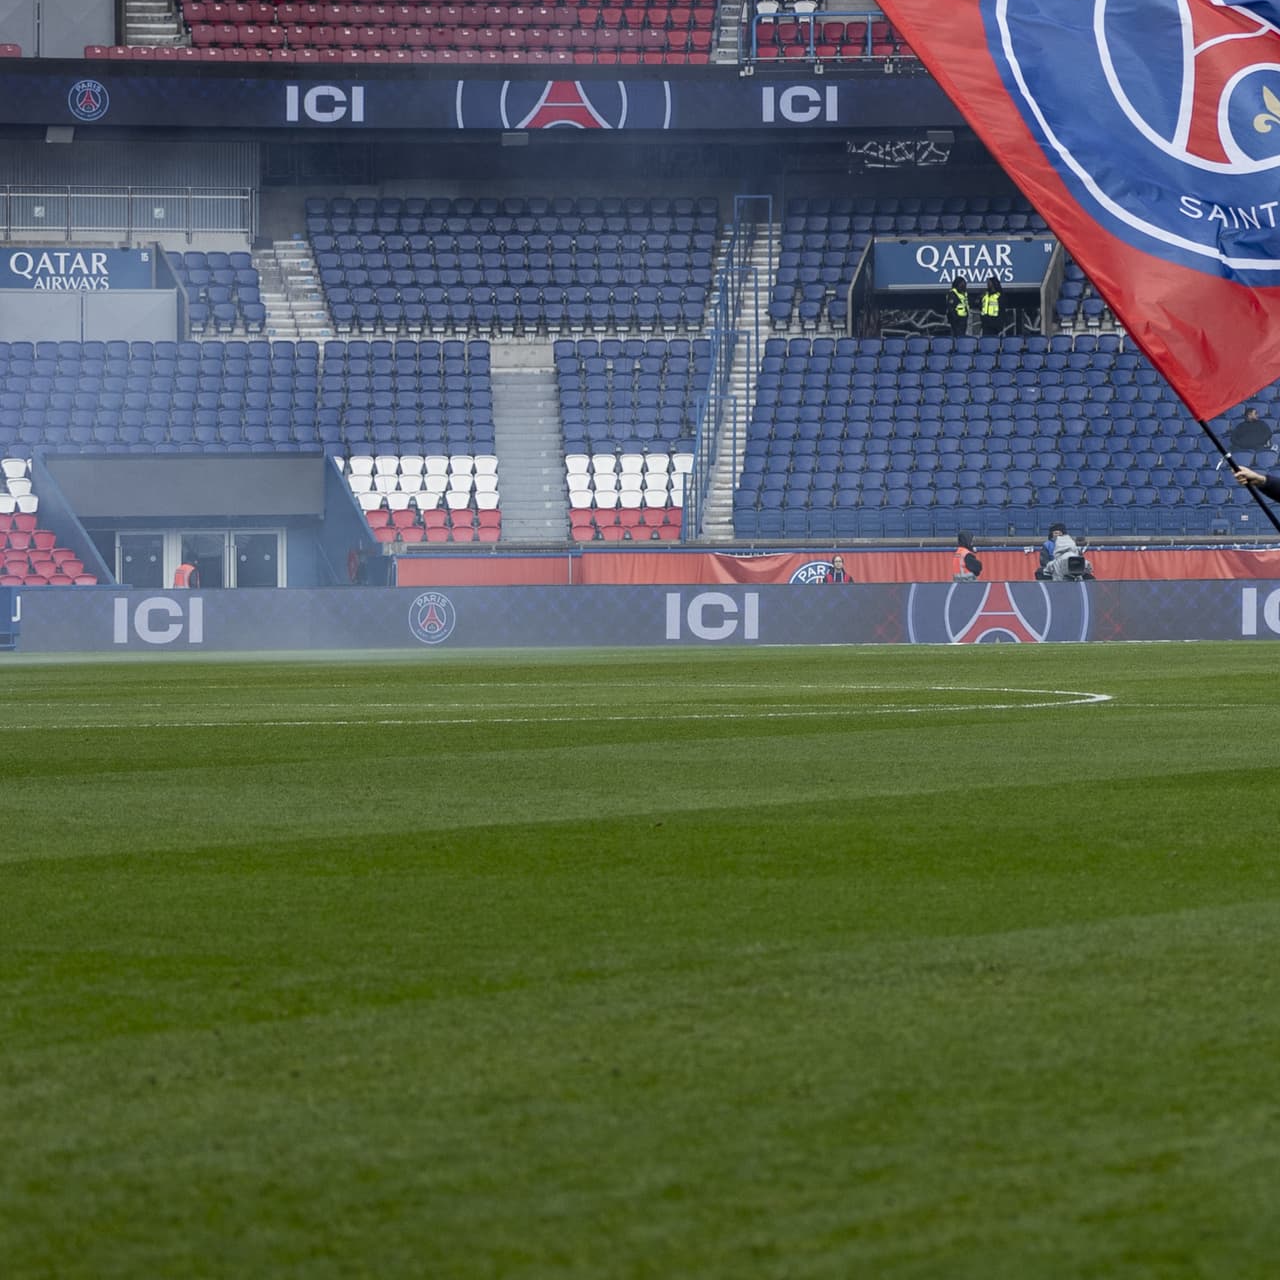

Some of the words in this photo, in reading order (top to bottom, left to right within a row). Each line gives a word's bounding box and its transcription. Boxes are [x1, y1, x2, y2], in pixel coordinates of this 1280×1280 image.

[286, 85, 364, 122] ICI
[761, 85, 838, 122] ICI
[1179, 195, 1278, 230] SAINT
[9, 251, 109, 279] QATAR
[916, 244, 1013, 272] QATAR
[33, 276, 110, 290] AIRWAYS
[939, 267, 1014, 283] AIRWAYS
[417, 594, 449, 608] PARIS
[665, 592, 760, 640] ICI
[113, 597, 204, 645] ICI
